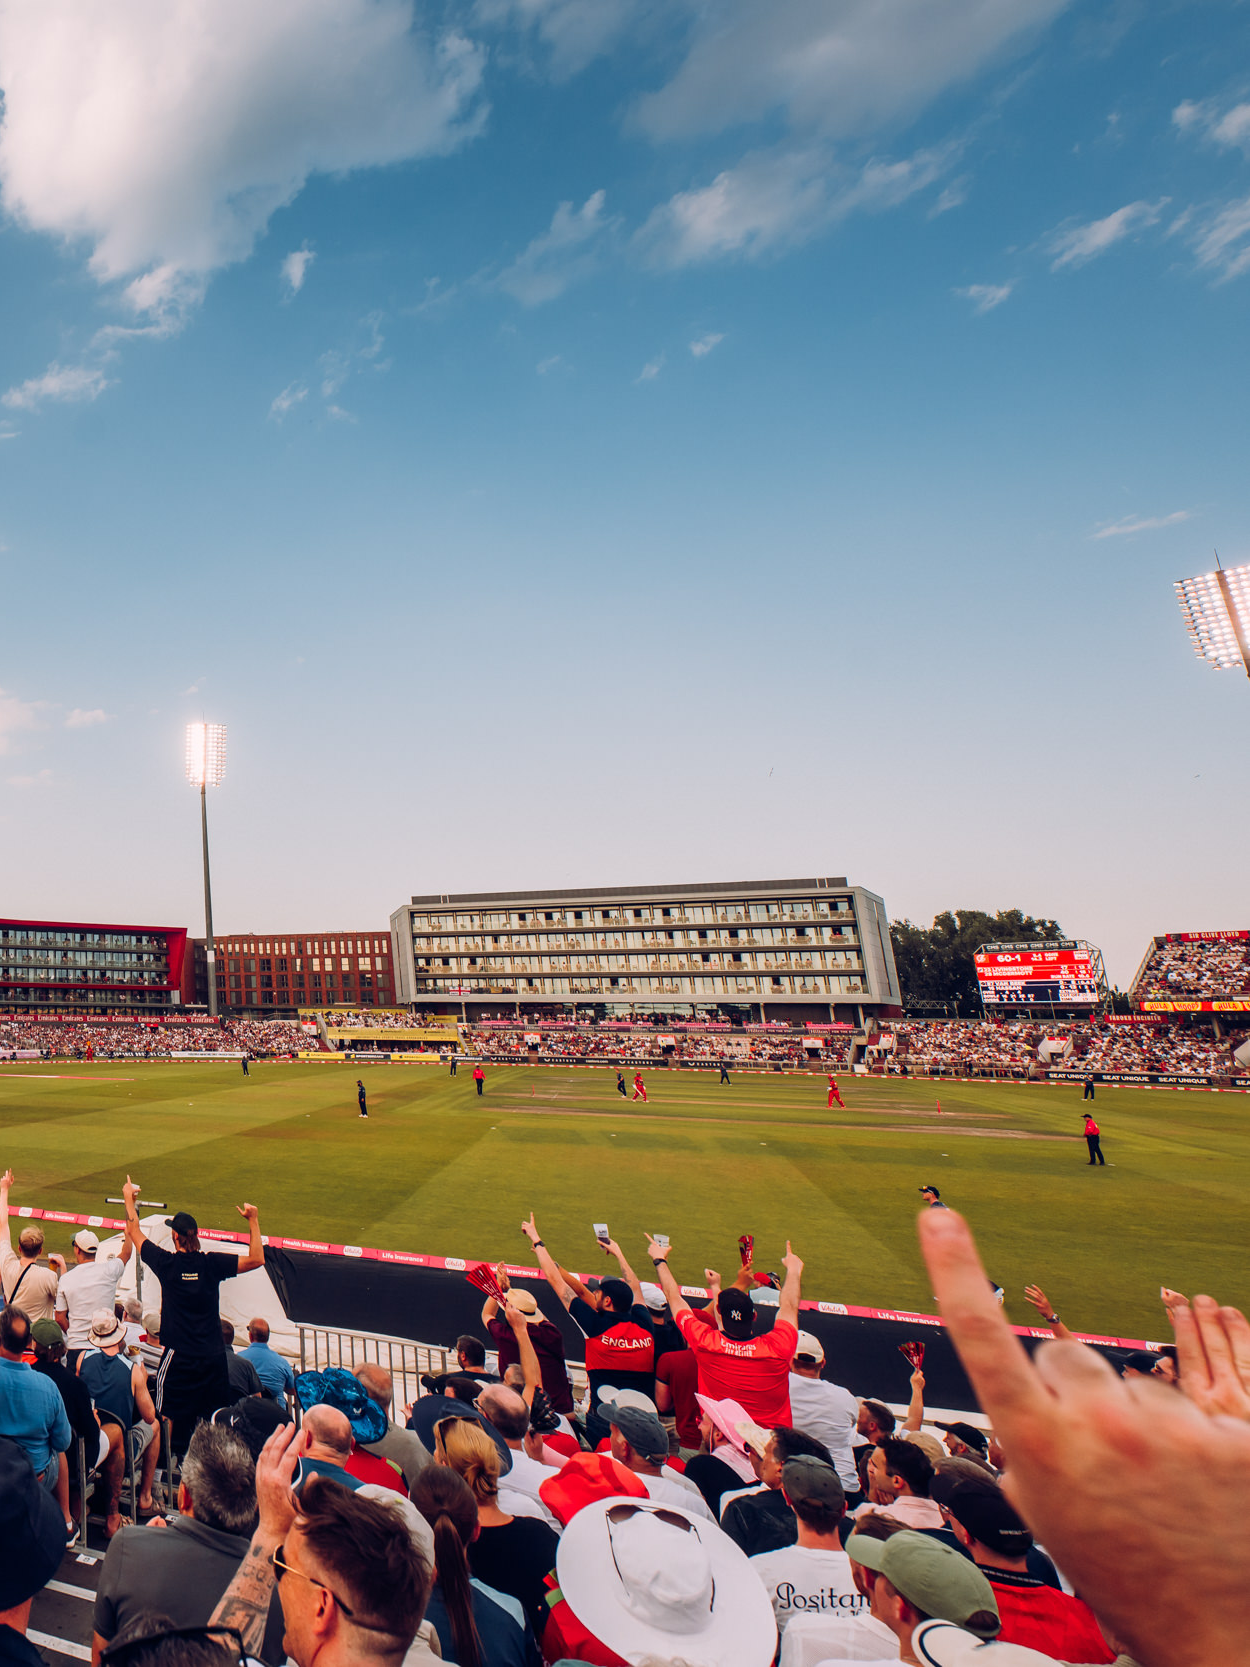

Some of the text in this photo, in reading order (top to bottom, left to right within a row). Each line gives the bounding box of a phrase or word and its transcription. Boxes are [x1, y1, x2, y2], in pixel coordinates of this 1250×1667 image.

[1178, 1002, 1199, 1010] HOOPS
[209, 1232, 234, 1240] Insurance
[283, 1239, 328, 1250] Health Insurance
[395, 1254, 424, 1263] Insurance
[506, 1268, 538, 1276] Insurance
[821, 1304, 846, 1314] Vitality
[877, 1312, 940, 1326] Life Insurance
[601, 1335, 652, 1348] ENGLAND
[721, 1338, 756, 1350] Emirates
[1031, 1330, 1118, 1347] Heal surance
[776, 1582, 871, 1613] Positan
